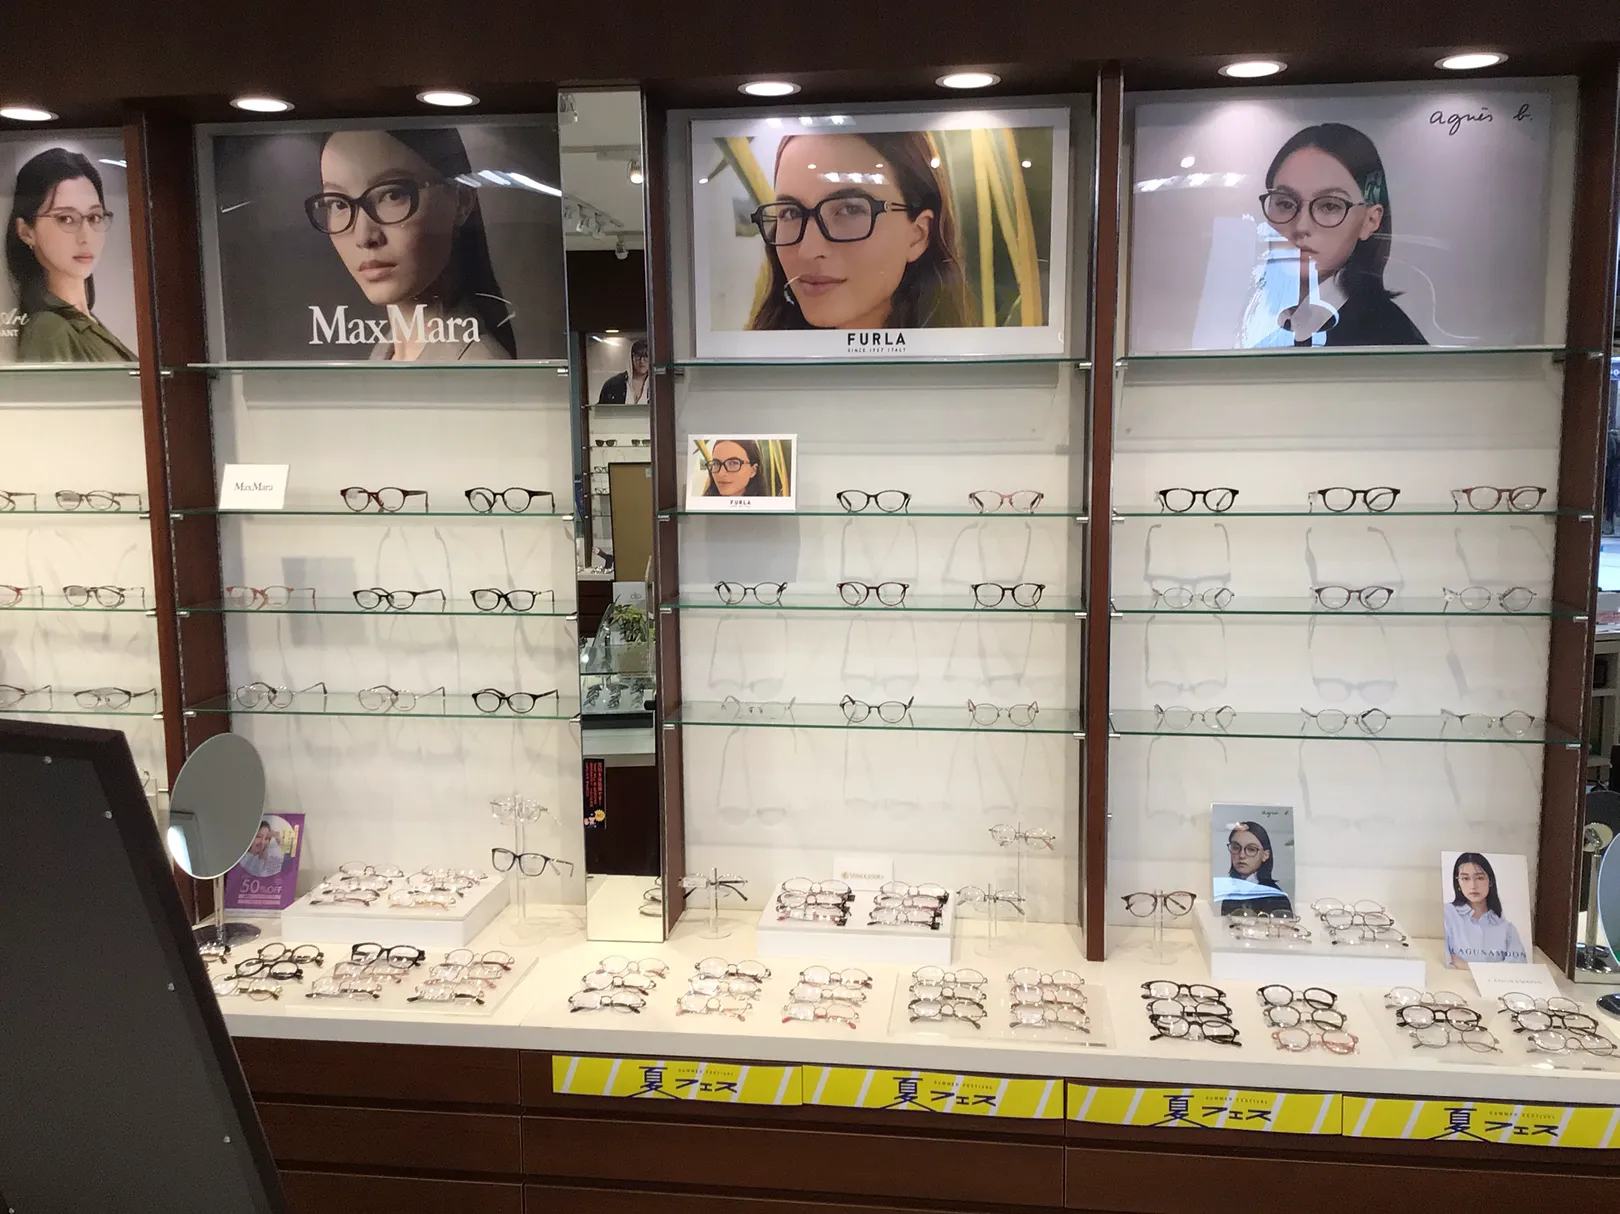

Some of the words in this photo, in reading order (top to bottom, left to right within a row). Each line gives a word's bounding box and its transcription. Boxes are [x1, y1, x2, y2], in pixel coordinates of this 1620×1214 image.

[308, 303, 481, 345] MaxMara
[847, 332, 906, 346] FURLA
[623, 1066, 738, 1100] 夏フェス
[880, 1077, 996, 1112] 夏フェス
[1147, 1095, 1272, 1128] 夏フェス
[1427, 1108, 1559, 1142] 夏フェス
